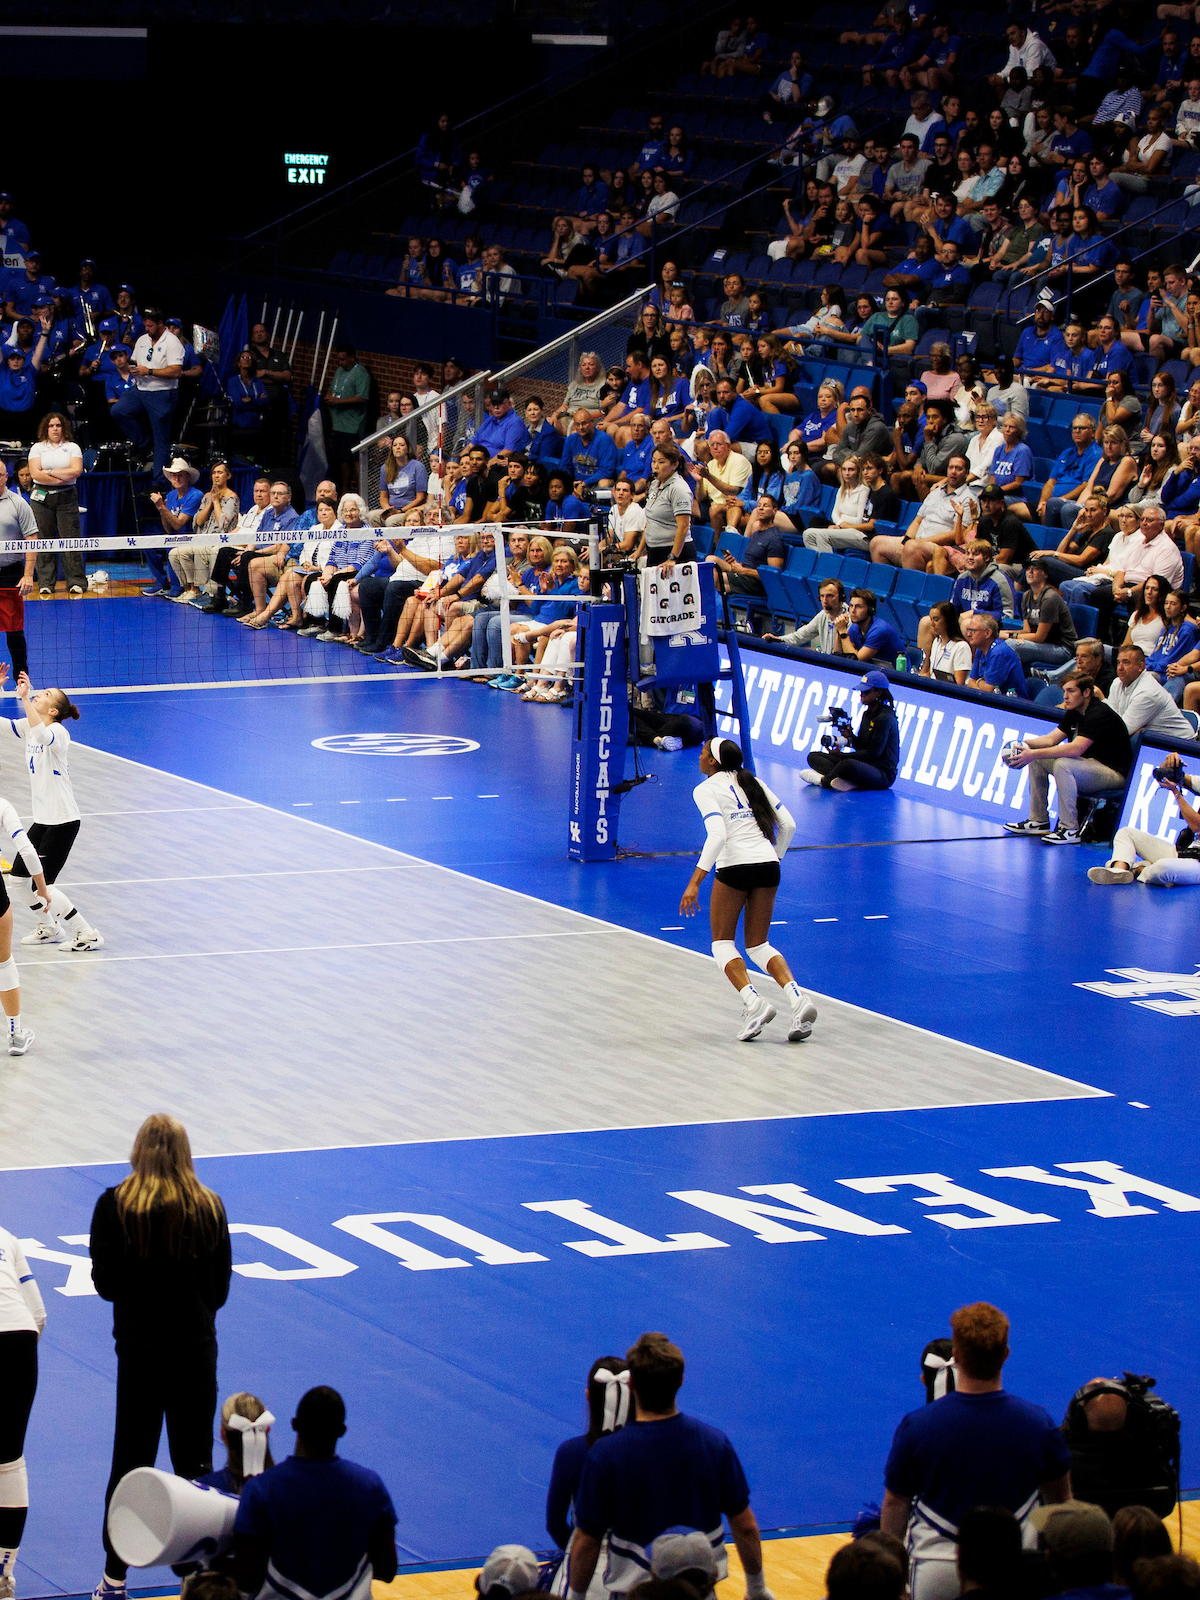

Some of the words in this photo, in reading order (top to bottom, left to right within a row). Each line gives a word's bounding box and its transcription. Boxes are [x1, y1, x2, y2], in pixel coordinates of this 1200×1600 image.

[284, 153, 329, 165] EMERGENCY
[287, 168, 326, 185] EXIT
[255, 531, 304, 542] KENTUCKY
[307, 529, 348, 539] WILDCATS
[4, 540, 55, 551] KENTUCKY
[58, 538, 100, 549] WILDCATS
[650, 611, 695, 624] GATORADE
[596, 621, 620, 844] WILDCATS
[890, 700, 1057, 811] WILDCAT
[29, 755, 36, 774] 4
[569, 820, 582, 844] UK
